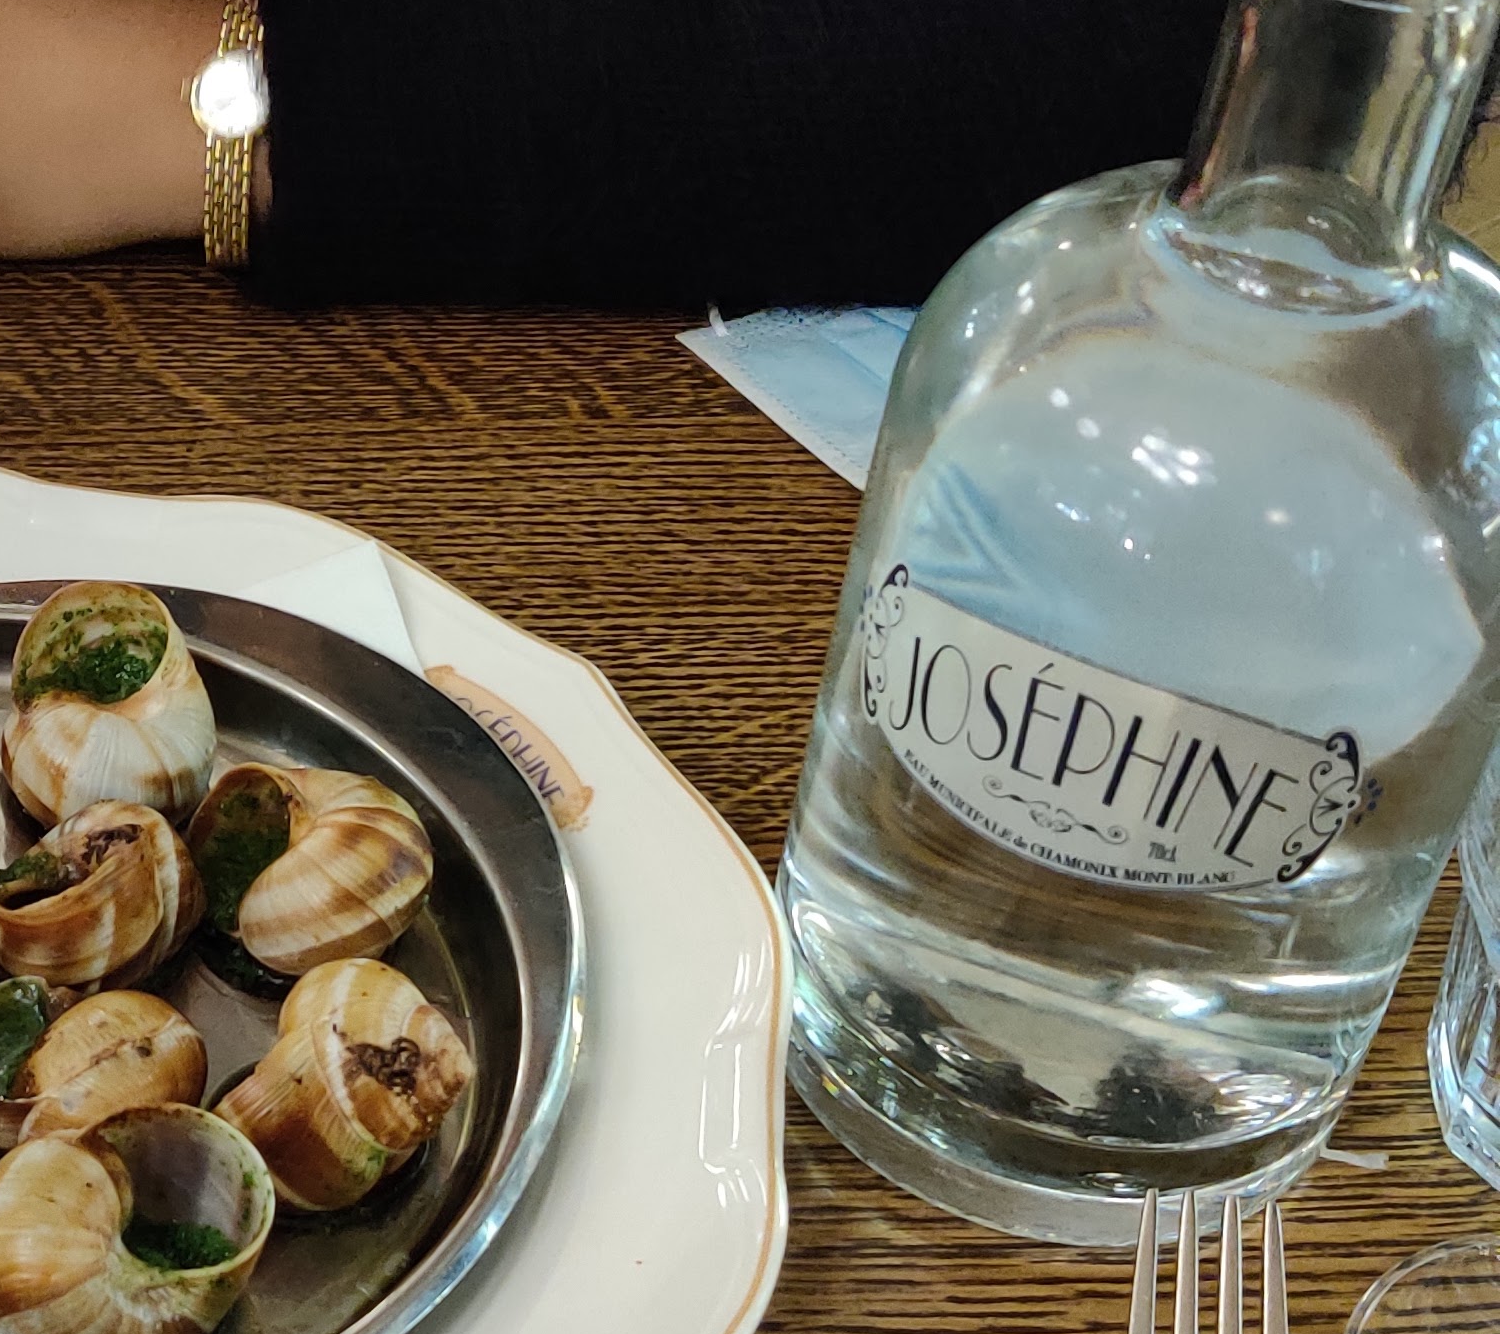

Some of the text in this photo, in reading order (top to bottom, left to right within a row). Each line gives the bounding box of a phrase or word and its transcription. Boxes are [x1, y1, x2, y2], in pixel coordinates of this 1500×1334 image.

[889, 636, 1299, 867] JOSÉPHINE
[1030, 842, 1119, 879] CHAMONIX
[1123, 868, 1170, 884] MONT
[1176, 870, 1235, 885] BLANC
